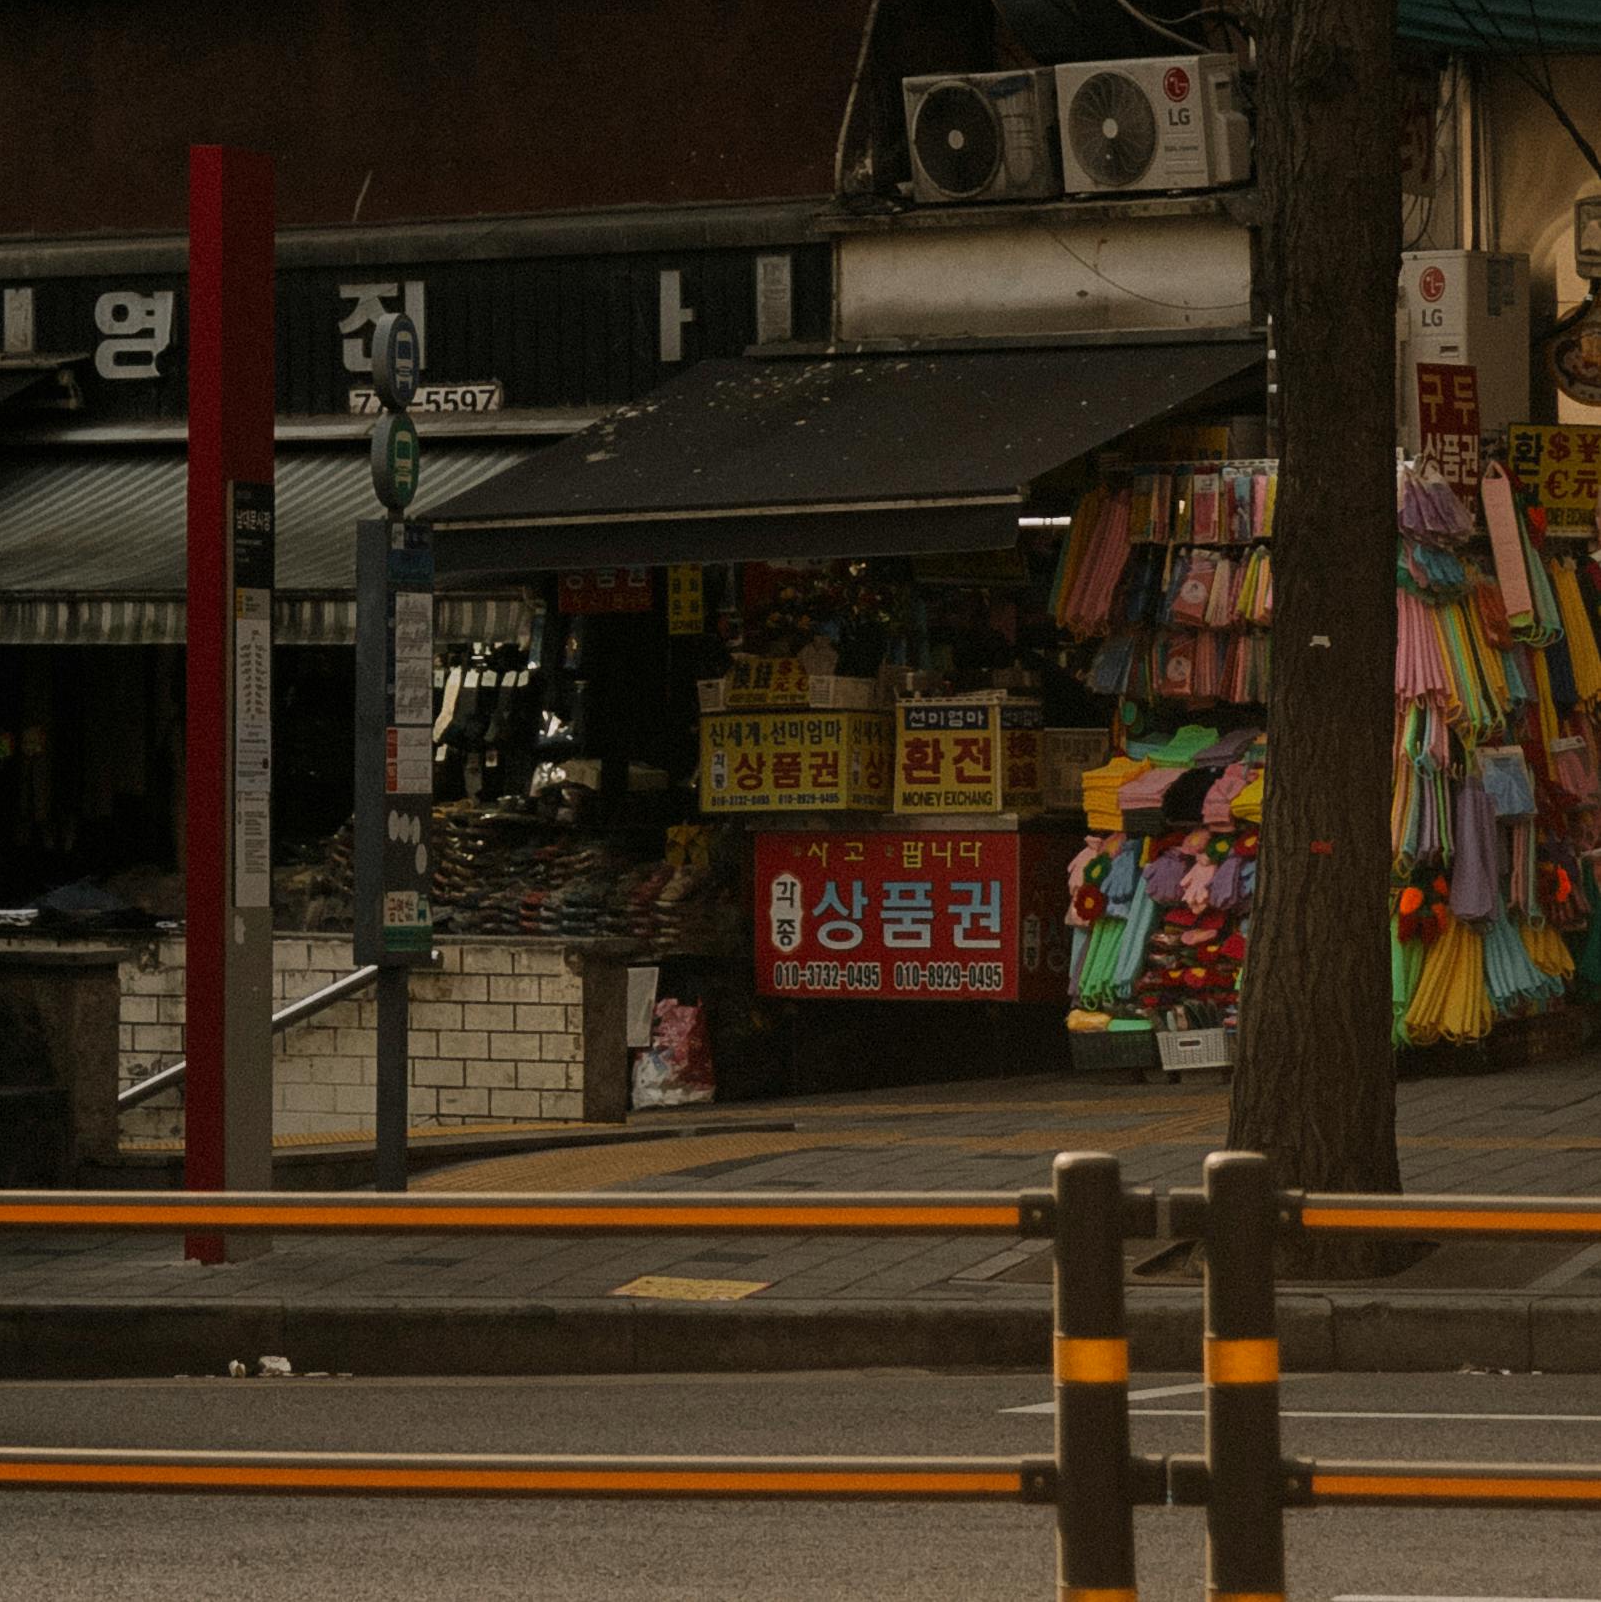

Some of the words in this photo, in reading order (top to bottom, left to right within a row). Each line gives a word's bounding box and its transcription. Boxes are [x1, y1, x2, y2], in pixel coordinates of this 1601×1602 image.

[1168, 108, 1190, 126] LG
[1422, 308, 1443, 327] LG
[1421, 374, 1475, 426] 구두
[909, 709, 985, 728] 선미엄마
[770, 720, 842, 745] 선미엄마
[734, 751, 839, 791] 상품권
[902, 738, 992, 785] 환전
[902, 792, 943, 807] MONEY
[808, 842, 867, 867] 사고
[902, 841, 982, 868] 팝니다
[776, 881, 796, 946] 각종
[812, 879, 1002, 950] 상품권
[774, 962, 881, 990] 010-3732-0495
[894, 962, 1003, 990] 010-8929-0495
